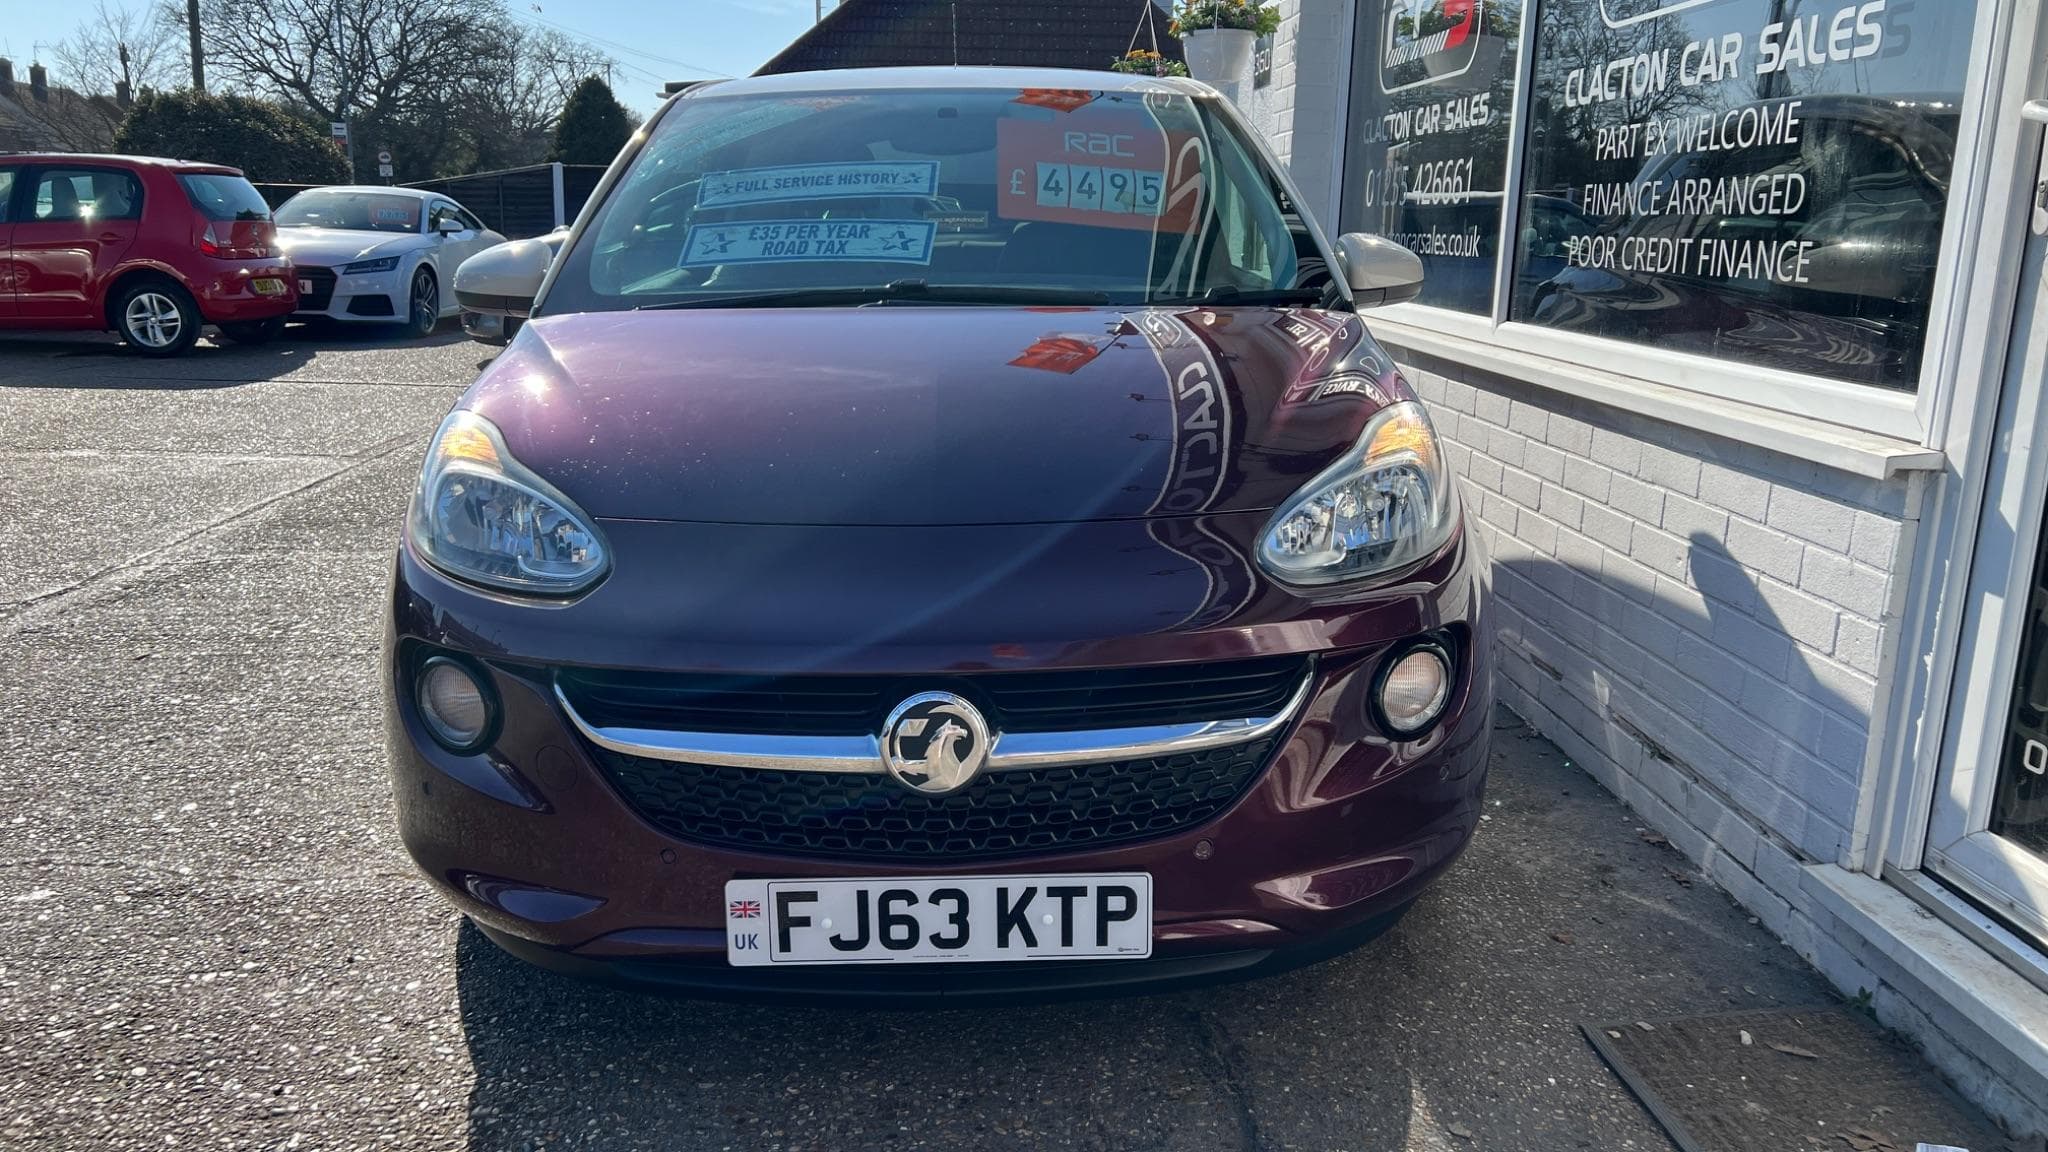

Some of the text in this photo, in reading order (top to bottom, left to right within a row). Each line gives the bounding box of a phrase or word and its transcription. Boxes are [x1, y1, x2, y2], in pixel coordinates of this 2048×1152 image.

[1565, 49, 1669, 107] CLACTON
[1680, 32, 1743, 86] CAR
[1756, 0, 1886, 74] SALES
[1363, 92, 1490, 144] CLACTON CAR SALES
[1596, 101, 1801, 161] PART EX WELCOME
[735, 172, 900, 193] FULL SERVICE HISTORY
[1412, 156, 1473, 205] 426661
[1583, 173, 1806, 216] FINANCE ARRANGED
[749, 224, 870, 241] £35 PER YEAR
[761, 240, 849, 256] ROAD TAX
[1568, 235, 1813, 283] POOR CREDIT FINANCE
[735, 934, 758, 950] UK
[776, 885, 1138, 953] FJ63 KTP
